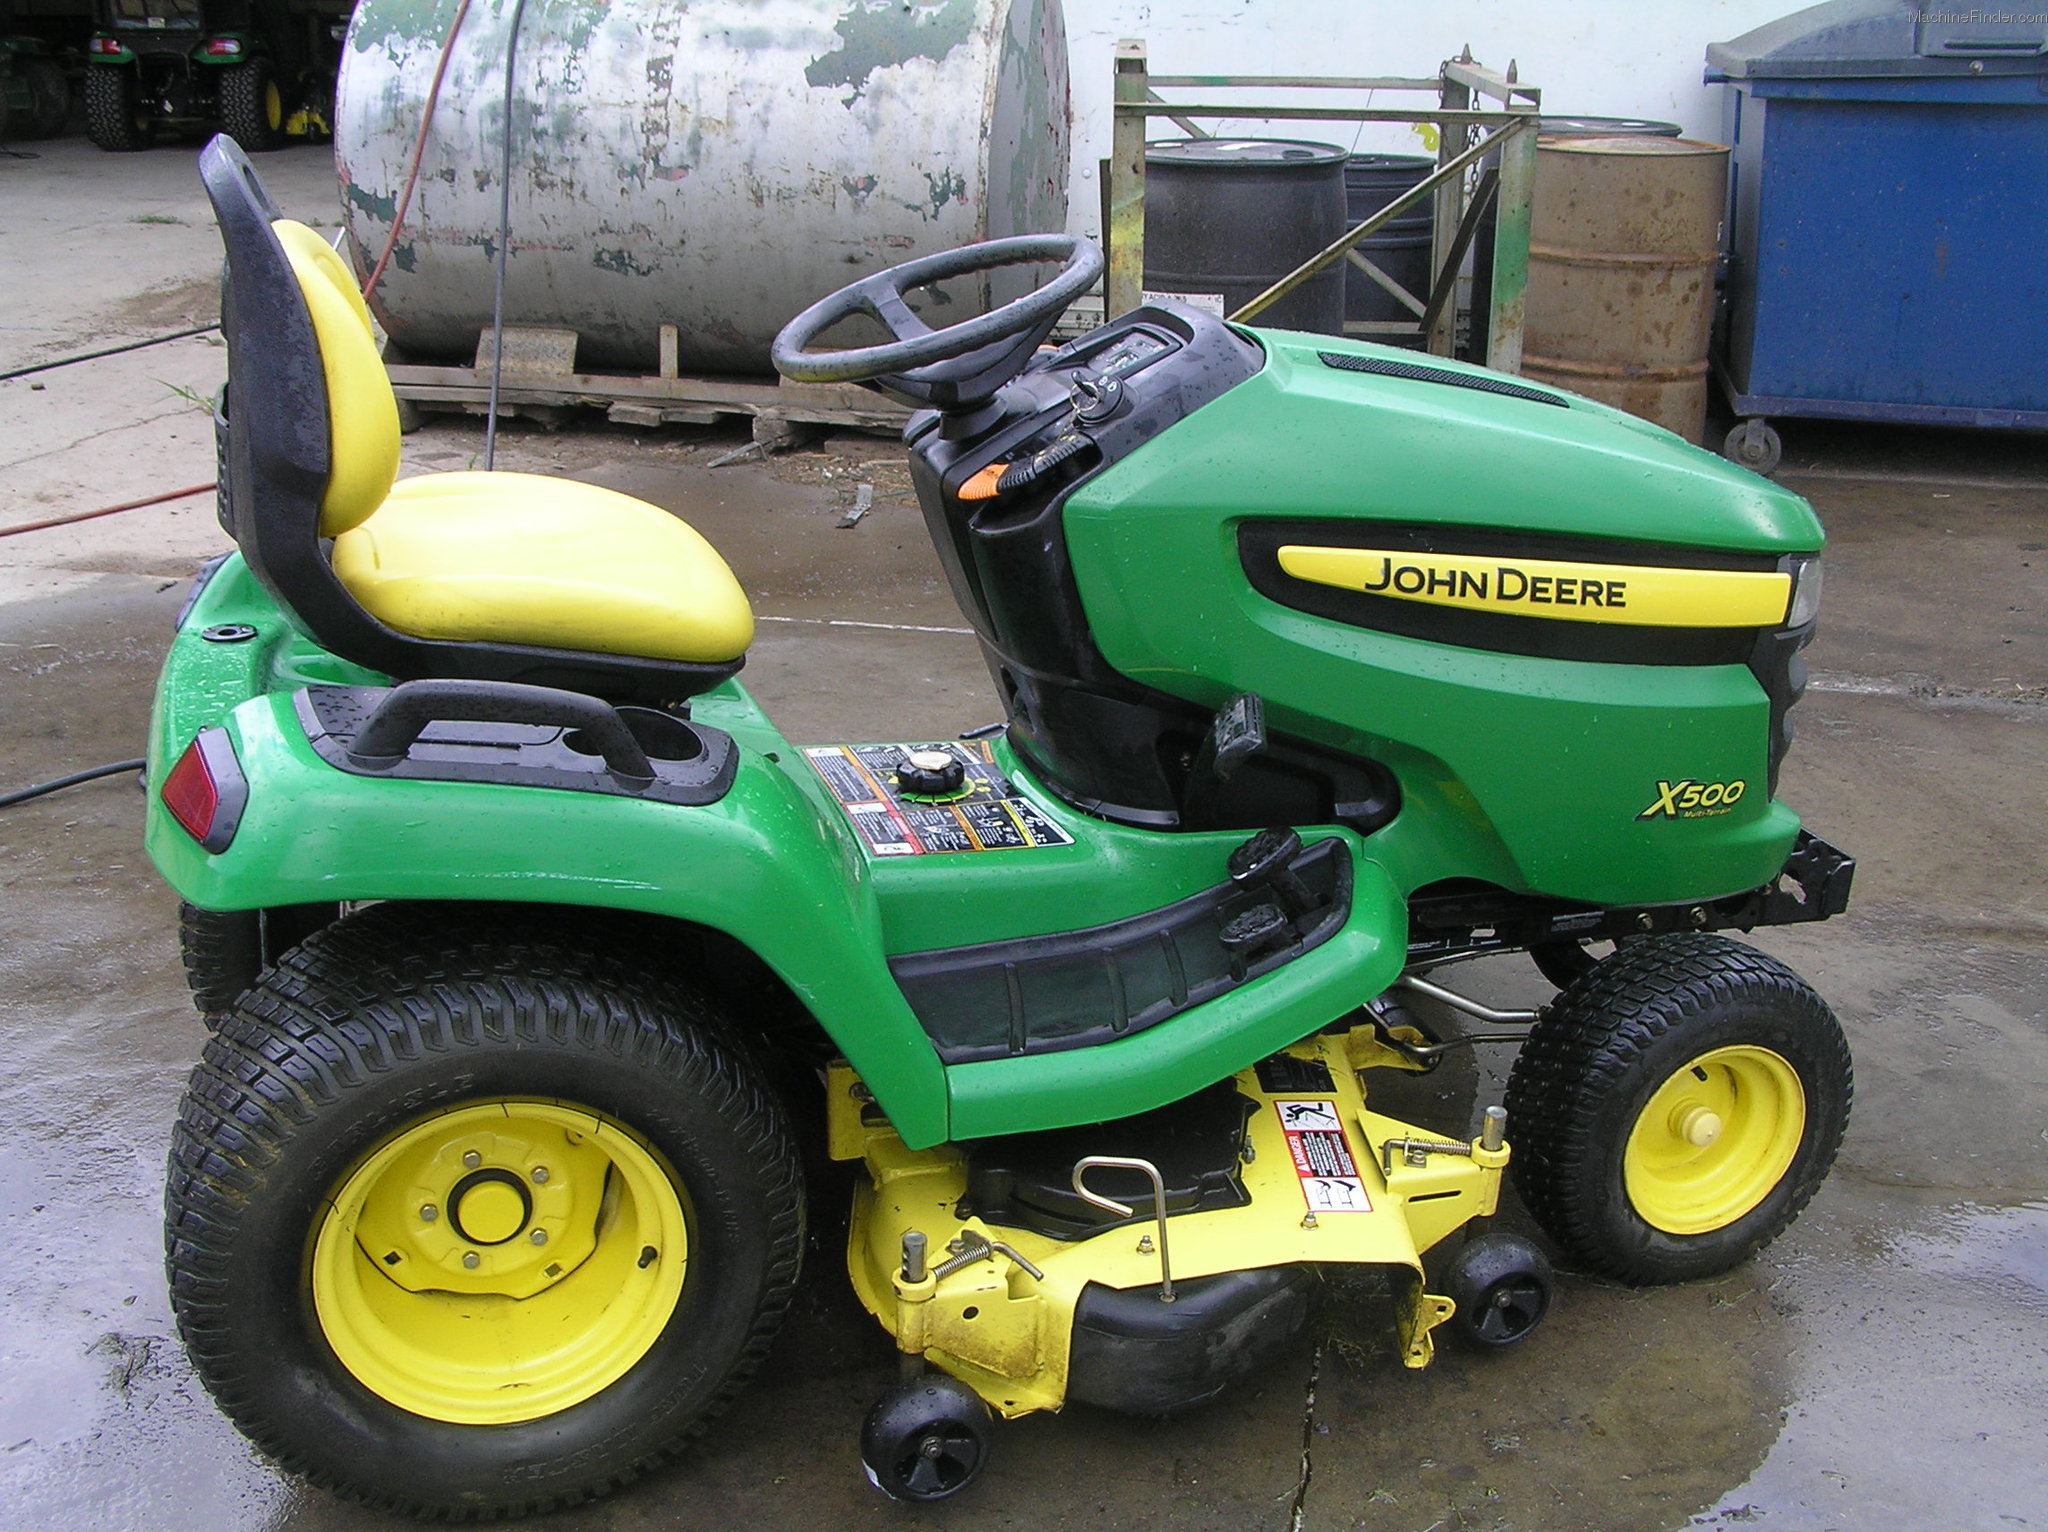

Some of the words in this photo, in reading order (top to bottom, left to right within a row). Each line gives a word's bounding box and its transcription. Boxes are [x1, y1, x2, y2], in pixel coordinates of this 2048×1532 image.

[1365, 558, 1487, 599] JOHN
[1497, 567, 1626, 607] DEERE
[1636, 779, 1746, 820] X500
[1289, 1135, 1306, 1165] DANGER
